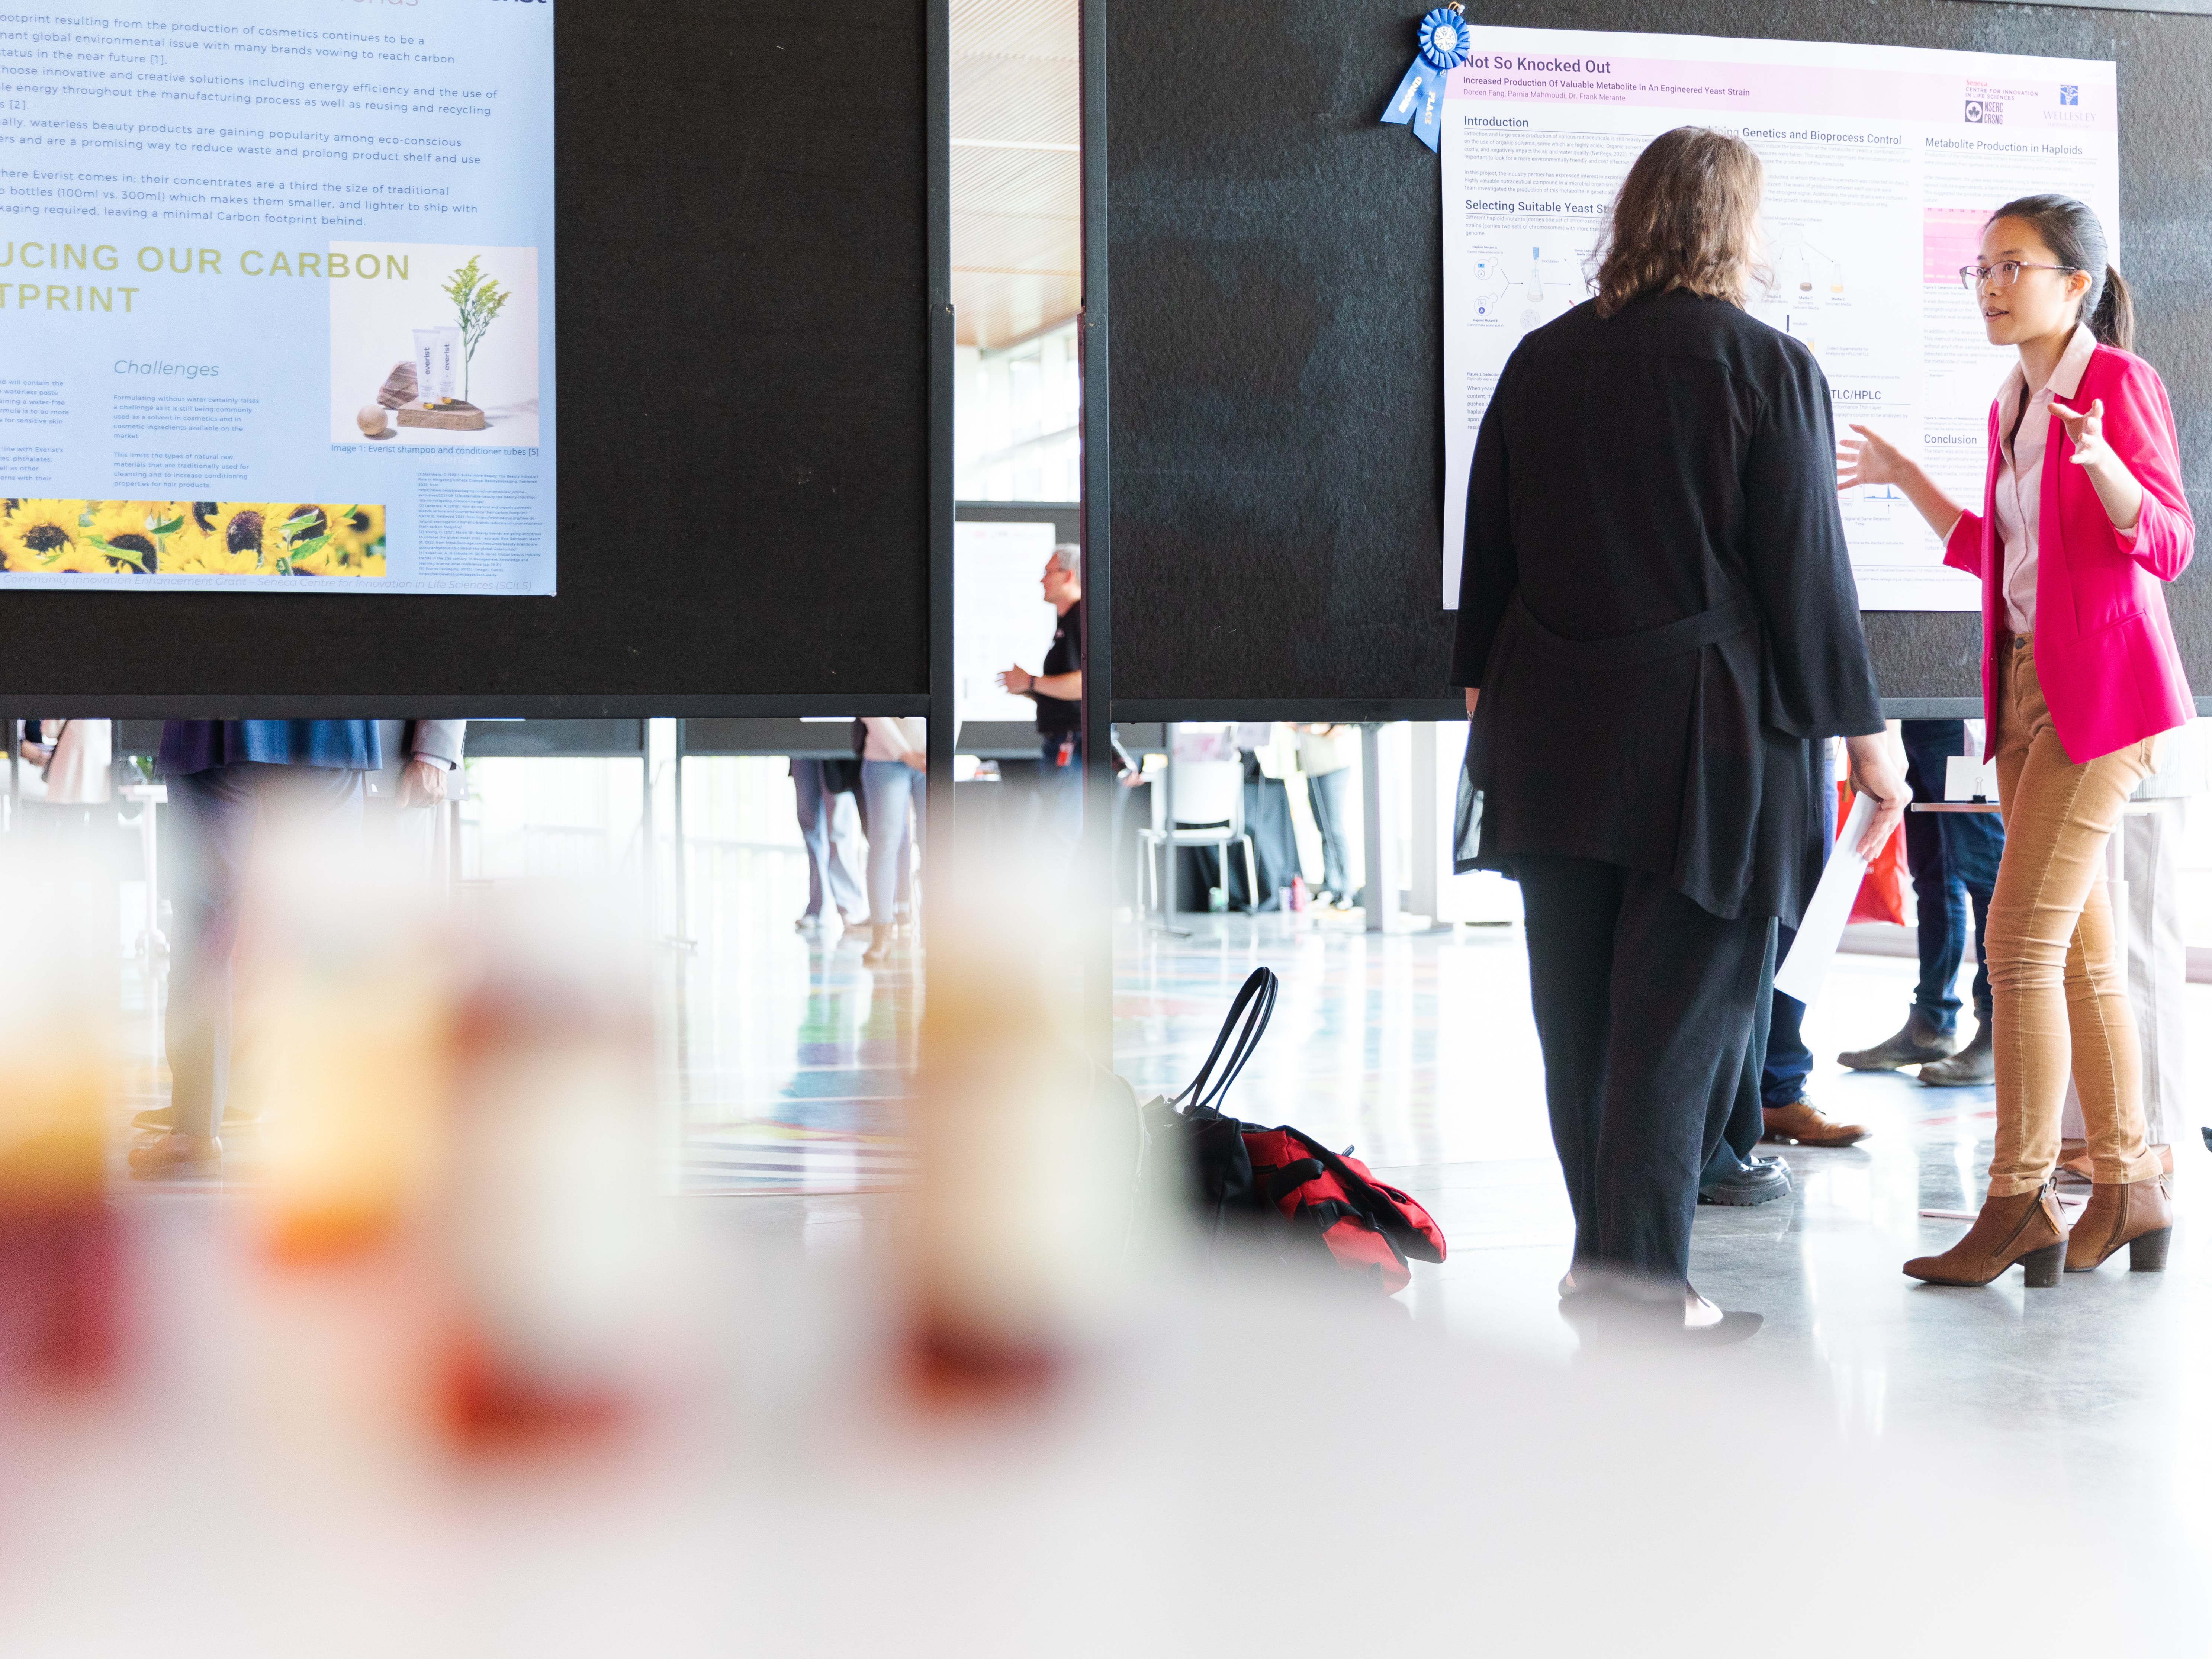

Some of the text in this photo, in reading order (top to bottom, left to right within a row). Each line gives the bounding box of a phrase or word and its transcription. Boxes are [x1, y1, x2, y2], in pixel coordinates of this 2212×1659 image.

[0, 14, 50, 24] ootprint
[55, 16, 109, 29] resulting
[114, 18, 142, 28] from
[147, 20, 167, 30] the
[172, 23, 238, 33] production
[243, 25, 255, 34] of
[258, 28, 318, 39] cosmetics
[322, 32, 380, 42] continues
[384, 35, 396, 44] to
[401, 35, 414, 45] be
[0, 32, 454, 63] nant global environmental issue with many brands vowing to reach carbon
[0, 48, 32, 58] tatus
[38, 49, 48, 58] in
[53, 50, 73, 60] the
[109, 52, 146, 63] future
[151, 55, 167, 65] [1].
[1464, 54, 1610, 74] Not So Knocked Out
[1464, 76, 1501, 85] Increased
[1504, 78, 1546, 87] Production
[1560, 80, 1594, 89] Valuable
[1597, 81, 1637, 90] Metabolite
[1661, 84, 1702, 94] Engineered
[1489, 90, 1506, 98] Fang,
[1531, 91, 1566, 99] Mahmoudi,
[1985, 102, 2003, 113] NSERC
[2044, 111, 2096, 121] WELLESLEY
[1465, 116, 1528, 127] Introduction
[1984, 114, 2002, 125] CRSNG
[1742, 128, 1786, 138] Genetics
[1790, 130, 1807, 139] and
[1811, 131, 1864, 143] Bioprocess
[1867, 134, 1901, 145] Control
[1926, 137, 2083, 155] Metabolite Production in Haploids
[1466, 199, 1514, 213] Selecting
[1518, 201, 1561, 212] Suitable
[1565, 203, 1593, 213] Yeast
[45, 206, 99, 216] required,
[105, 207, 147, 219] leaving
[163, 210, 212, 220] minimal
[217, 212, 260, 222] Carbon
[264, 213, 317, 225] footprint
[322, 216, 366, 226] behind.
[0, 242, 408, 280] UCING OUR CARBON
[0, 284, 139, 312] TPRINT
[114, 360, 219, 379] Challenges
[1830, 390, 1881, 399] TLC/HPLC
[1924, 434, 1977, 444] Conclusion
[332, 444, 356, 454] Image
[398, 446, 435, 455] shampoo
[456, 447, 501, 455] conditioner
[529, 448, 538, 457] [5]
[3, 573, 531, 592] Community Innovation Enhancement Grant Seneca Centre for Innovation in Life Sciences (SCILS)
